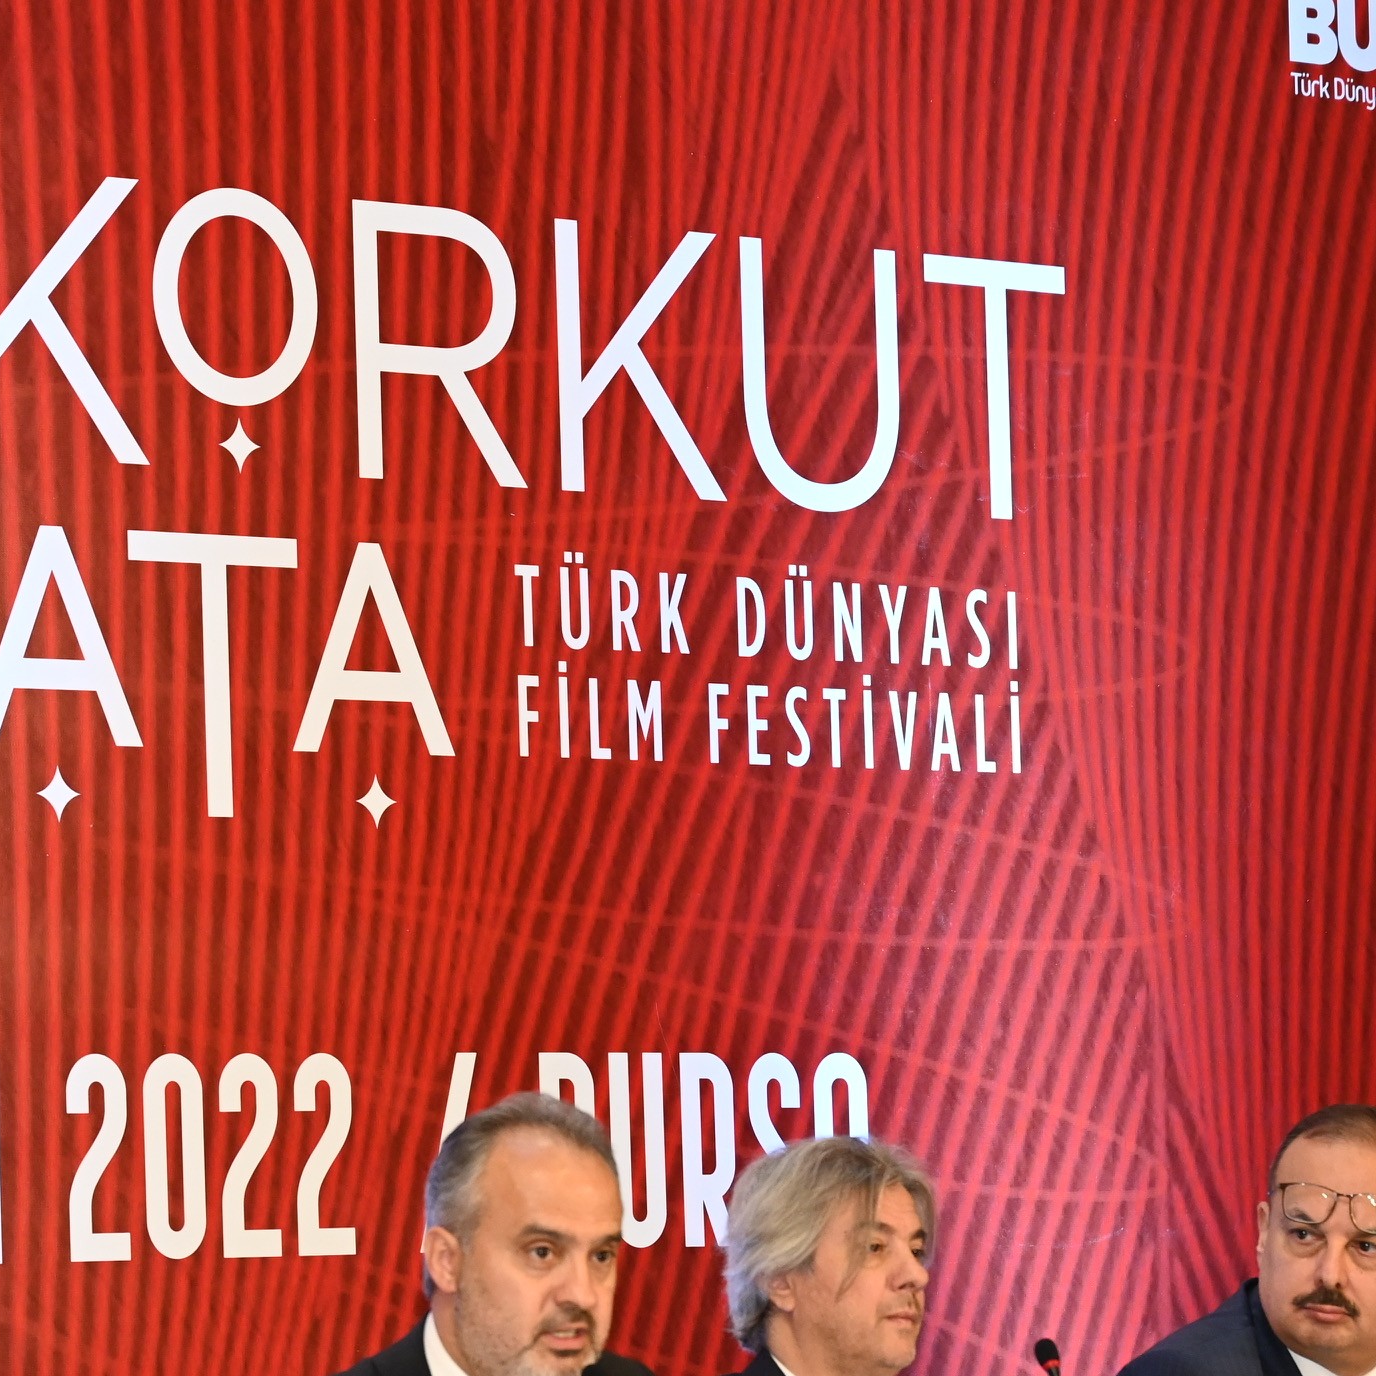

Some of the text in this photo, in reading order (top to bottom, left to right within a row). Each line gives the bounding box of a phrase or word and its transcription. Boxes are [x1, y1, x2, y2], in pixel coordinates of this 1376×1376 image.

[1290, 72, 1330, 98] Türk
[515, 552, 1018, 670] TÜRK DÜNYASI
[518, 660, 1023, 774] FİLM FESTİVALİ
[65, 1051, 358, 1263] 2022
